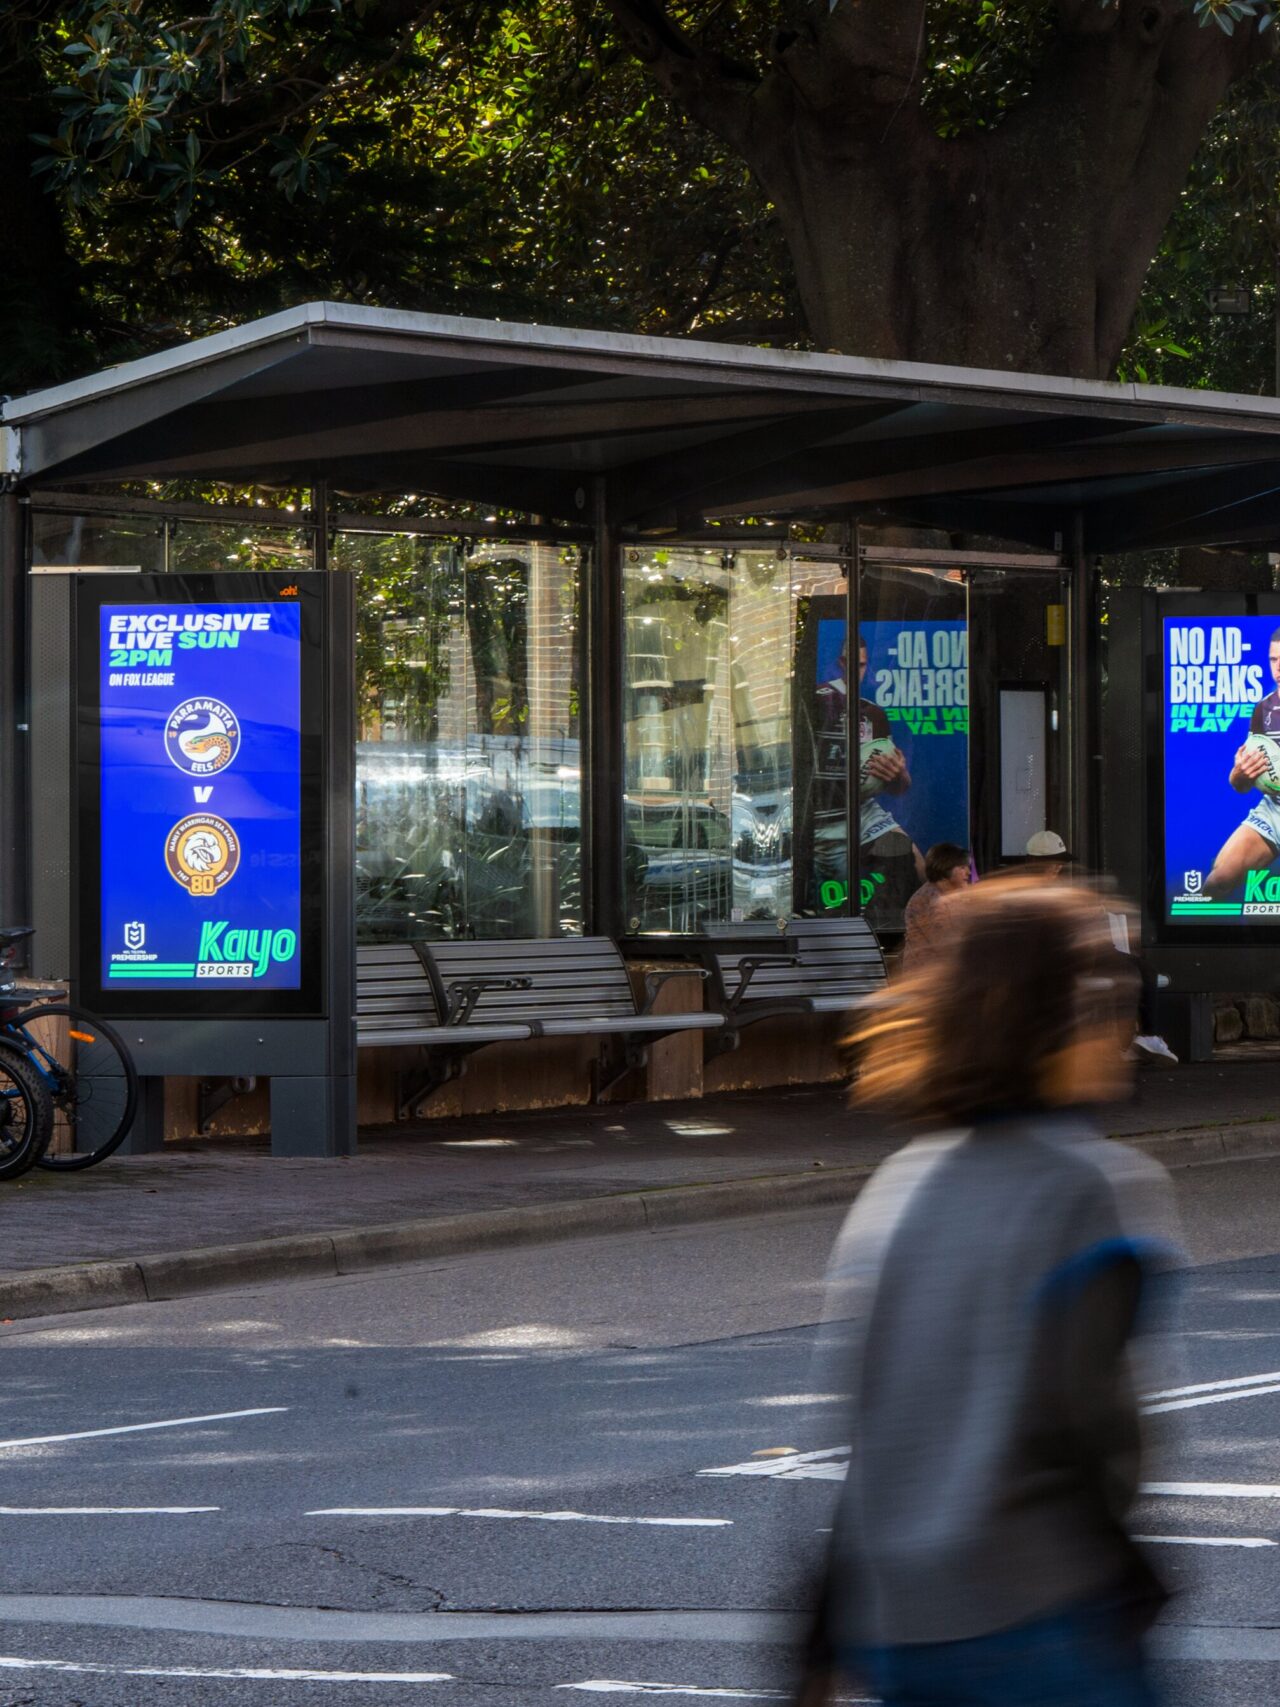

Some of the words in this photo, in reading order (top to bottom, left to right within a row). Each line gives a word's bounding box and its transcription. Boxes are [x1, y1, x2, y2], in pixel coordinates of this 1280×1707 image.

[109, 613, 271, 632] EXCLUSIVE
[109, 632, 174, 650] LIVE
[178, 631, 240, 649] SUN
[1170, 627, 1205, 665] NO
[1209, 627, 1251, 664] AD-
[109, 649, 173, 667] 2PM
[109, 673, 123, 686] ON
[124, 673, 141, 686] FOX
[142, 672, 175, 686] LEAGUE
[1170, 665, 1263, 703] BREAKS
[170, 701, 234, 729] PARRAMATTA
[1170, 704, 1198, 718] IN
[1201, 704, 1255, 718] LIVE
[1170, 718, 1234, 732] PLAY
[191, 762, 214, 772] EELS
[169, 831, 182, 852] MANLY
[214, 821, 226, 832] SEA
[223, 829, 236, 852] EAGLES
[191, 875, 214, 893] 80
[198, 921, 296, 977] Kayo
[200, 965, 250, 975] SPORTS
